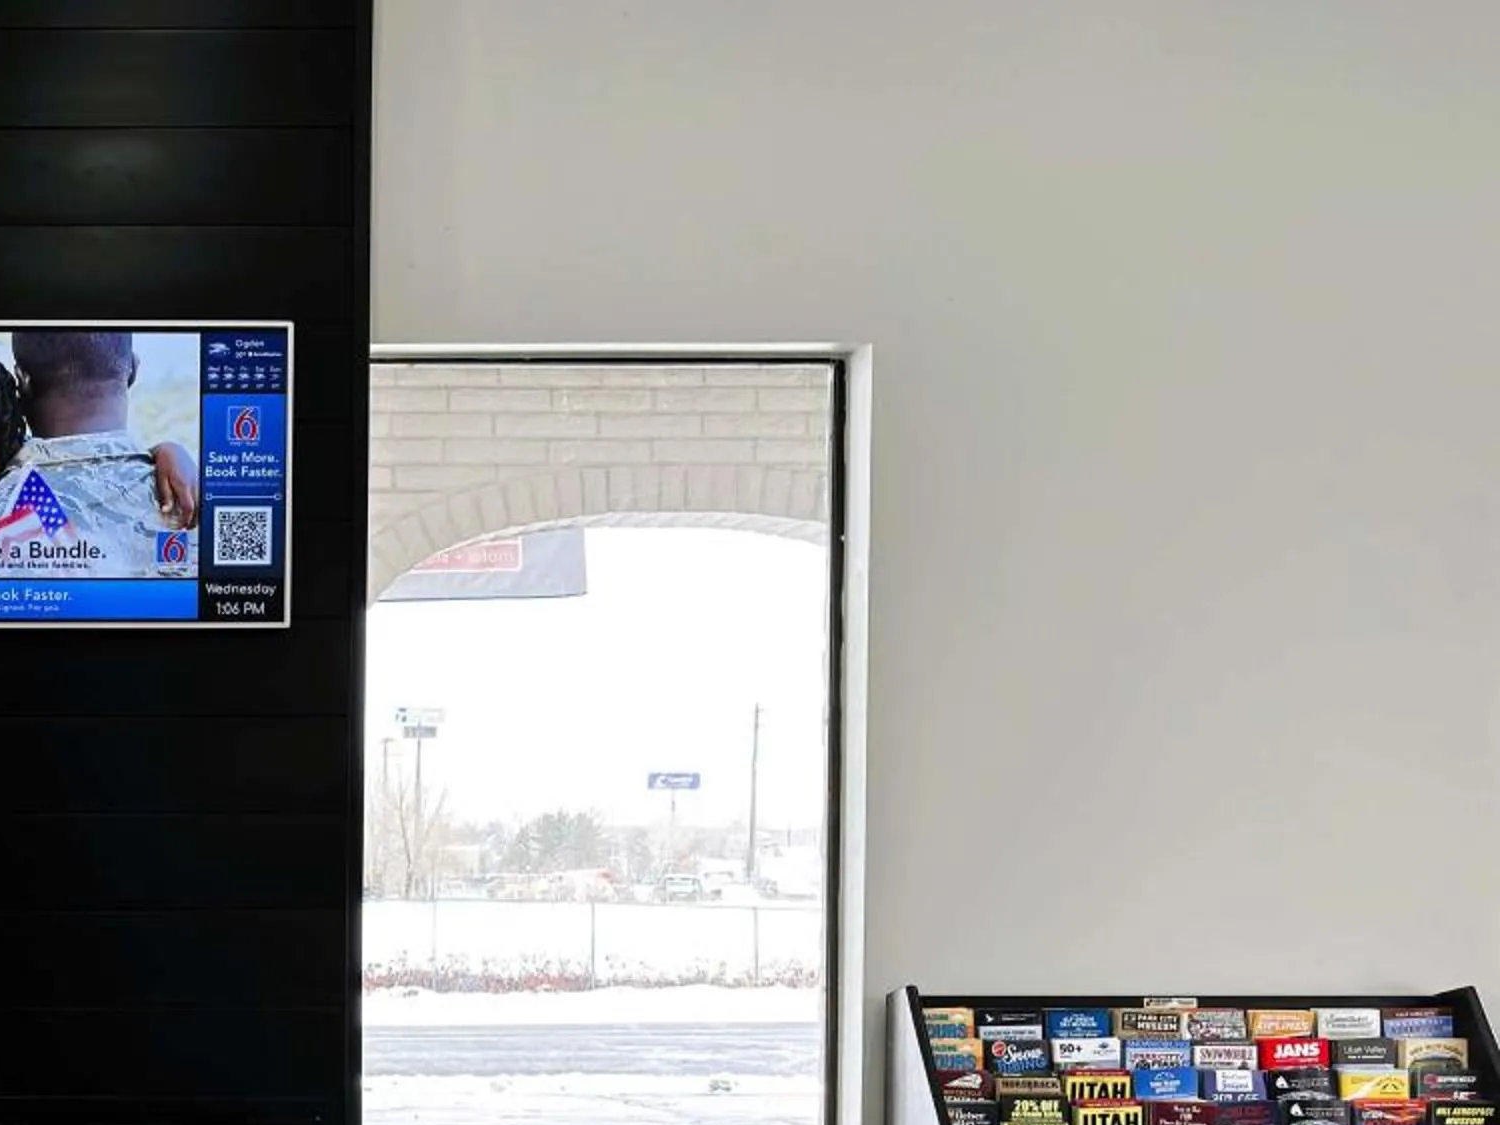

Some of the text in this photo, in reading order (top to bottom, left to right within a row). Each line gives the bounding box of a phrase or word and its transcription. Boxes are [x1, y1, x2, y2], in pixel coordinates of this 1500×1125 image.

[208, 452, 279, 463] Save More.
[205, 466, 282, 478] Book Faster.
[10, 545, 21, 559] a
[30, 540, 106, 559] Bundle.
[163, 530, 186, 563] 6
[25, 588, 72, 601] Faster.
[205, 583, 276, 597] Wednesday
[216, 602, 265, 615] 1:06 PM
[1273, 1042, 1321, 1058] JANS
[1071, 1082, 1127, 1099] UTAH
